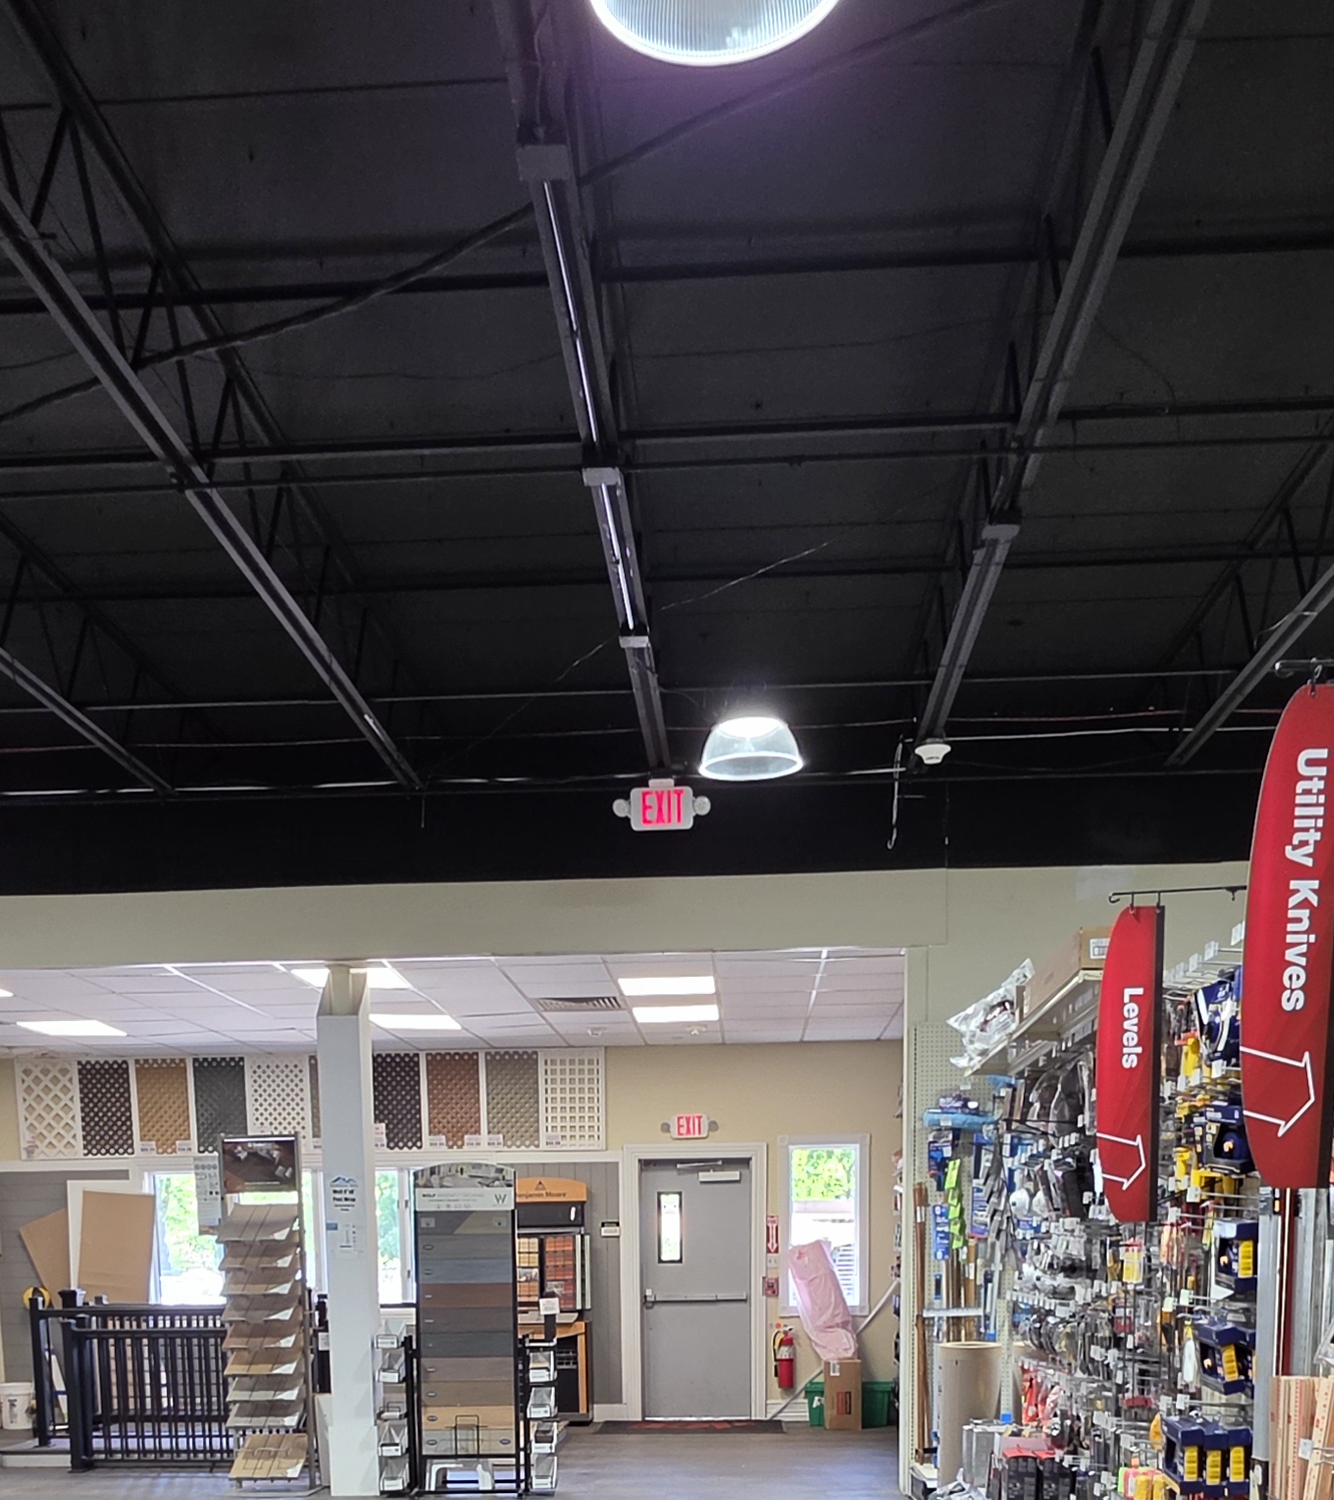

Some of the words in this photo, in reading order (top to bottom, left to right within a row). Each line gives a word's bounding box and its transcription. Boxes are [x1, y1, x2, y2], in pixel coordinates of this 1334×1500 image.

[641, 789, 684, 826] EXIT
[1283, 746, 1330, 869] Utility
[1280, 878, 1320, 1013] Knives
[1122, 987, 1145, 1070] Levels
[677, 1115, 703, 1137] EXIT
